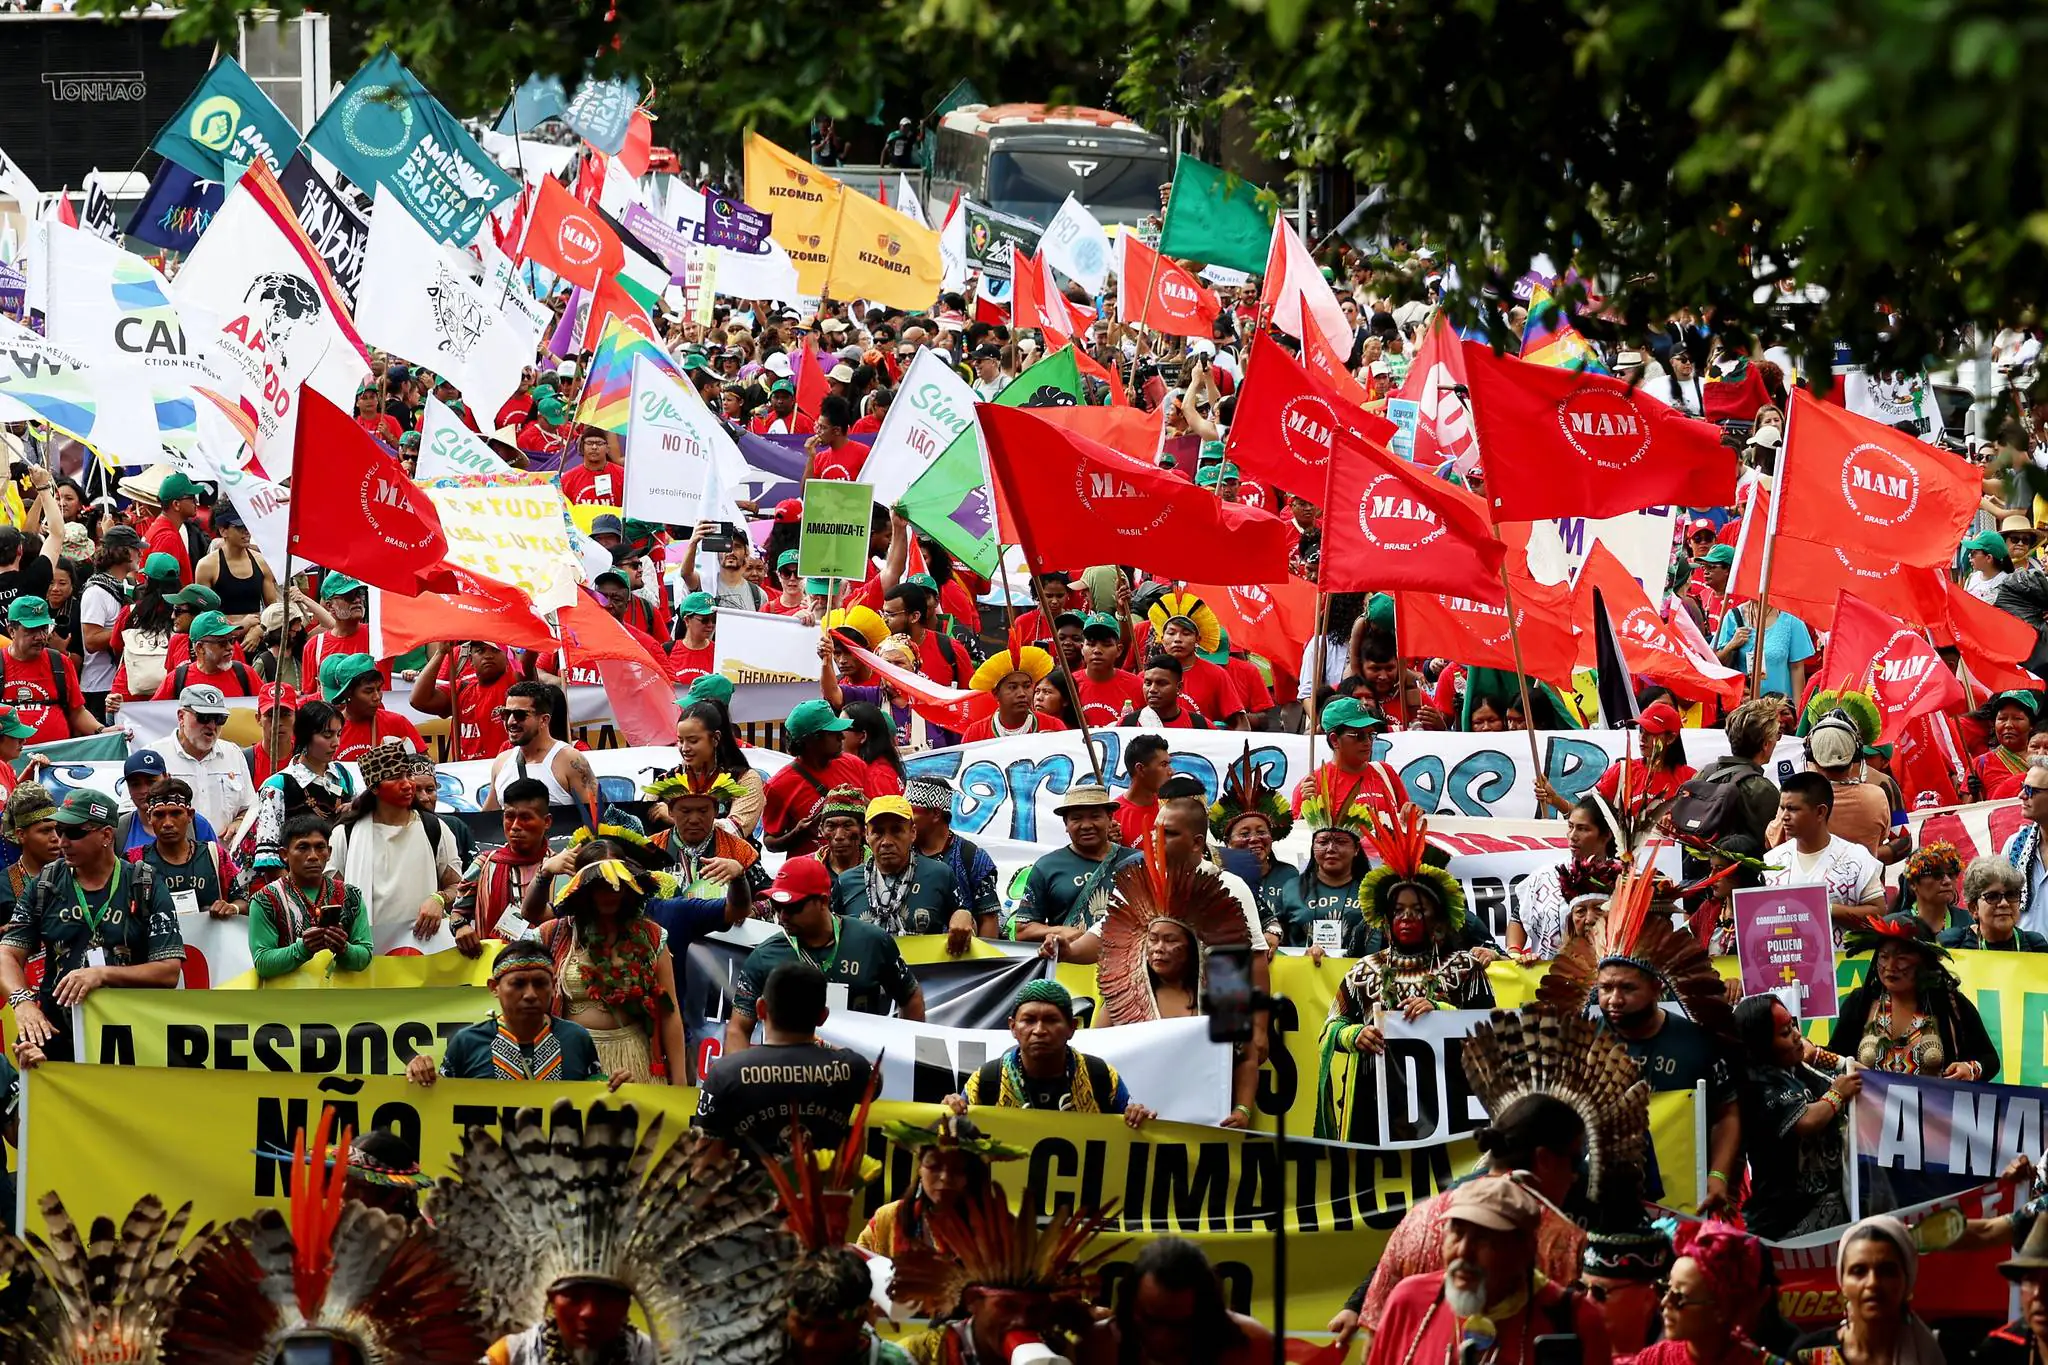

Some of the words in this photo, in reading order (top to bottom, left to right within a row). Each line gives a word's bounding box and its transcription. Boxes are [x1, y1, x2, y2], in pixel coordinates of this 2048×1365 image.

[410, 145, 427, 171] DA
[426, 167, 467, 212] TERRA
[397, 157, 455, 227] BRASIL
[768, 186, 823, 202] KIZOMBA
[564, 224, 596, 253] MAM
[858, 250, 911, 276] KIZOMBA
[144, 358, 179, 368] CTION
[1569, 412, 1640, 437] MAM
[661, 433, 680, 452] NO
[905, 423, 936, 460] NÃO
[1558, 415, 1588, 456] MOVIMENTO
[430, 428, 497, 474] Sim
[1843, 451, 1856, 468] PELA
[1597, 459, 1622, 470] BRASIL
[1089, 473, 1138, 498] MA
[1361, 482, 1377, 502] PELA
[1841, 468, 1858, 510] MOVIMENTO
[1851, 465, 1908, 501] MAM
[361, 481, 380, 529] MOVIMENTO
[373, 478, 415, 514] MA
[1369, 496, 1437, 525] MAM
[1863, 514, 1889, 526] BRASIL
[806, 522, 865, 538] AMAZONIZA-TE
[1359, 502, 1378, 543] MOVIMENTO
[384, 535, 409, 551] BRASIL
[1383, 542, 1412, 551] BRASIL
[1856, 568, 1883, 580] BRASIL
[1872, 646, 1890, 662] PELA
[1878, 655, 1930, 682] MAM
[165, 876, 185, 889] OP
[190, 876, 205, 889] 30
[1308, 896, 1339, 910] COP
[1344, 897, 1361, 909] 30
[1778, 906, 1786, 914] AS
[103, 909, 123, 925] 30
[1767, 938, 1803, 952] POLUEM
[840, 960, 859, 975] 30
[740, 1060, 850, 1087] COORDENAÇÃO
[1655, 1055, 1676, 1075] 30
